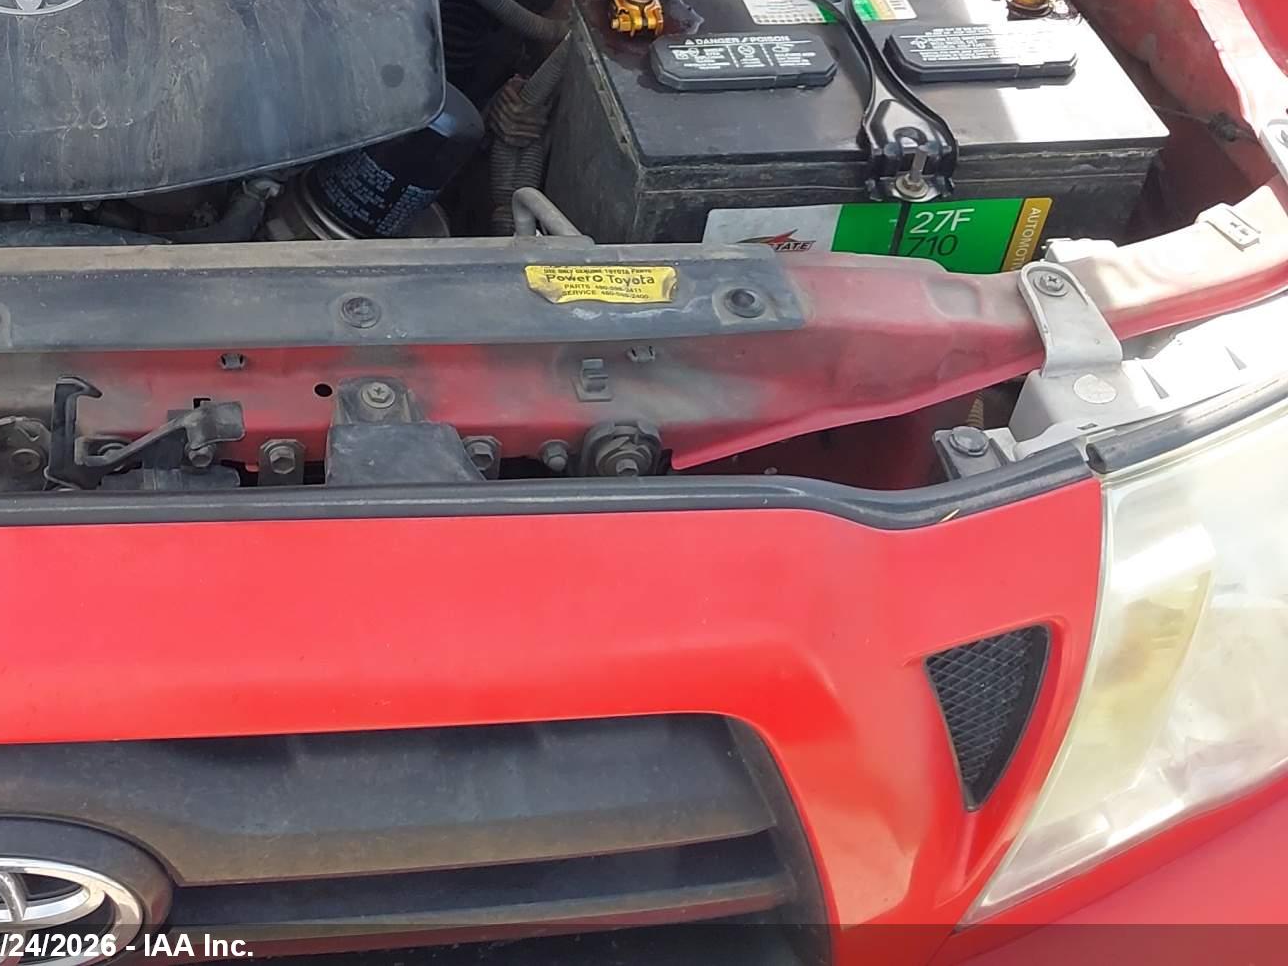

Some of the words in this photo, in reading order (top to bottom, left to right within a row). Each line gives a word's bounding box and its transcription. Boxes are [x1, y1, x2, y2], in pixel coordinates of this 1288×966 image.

[695, 37, 740, 45] DANGER
[750, 35, 791, 43] POISON
[909, 207, 976, 235] 27F
[907, 233, 959, 257] 710
[606, 274, 656, 286] Toyota
